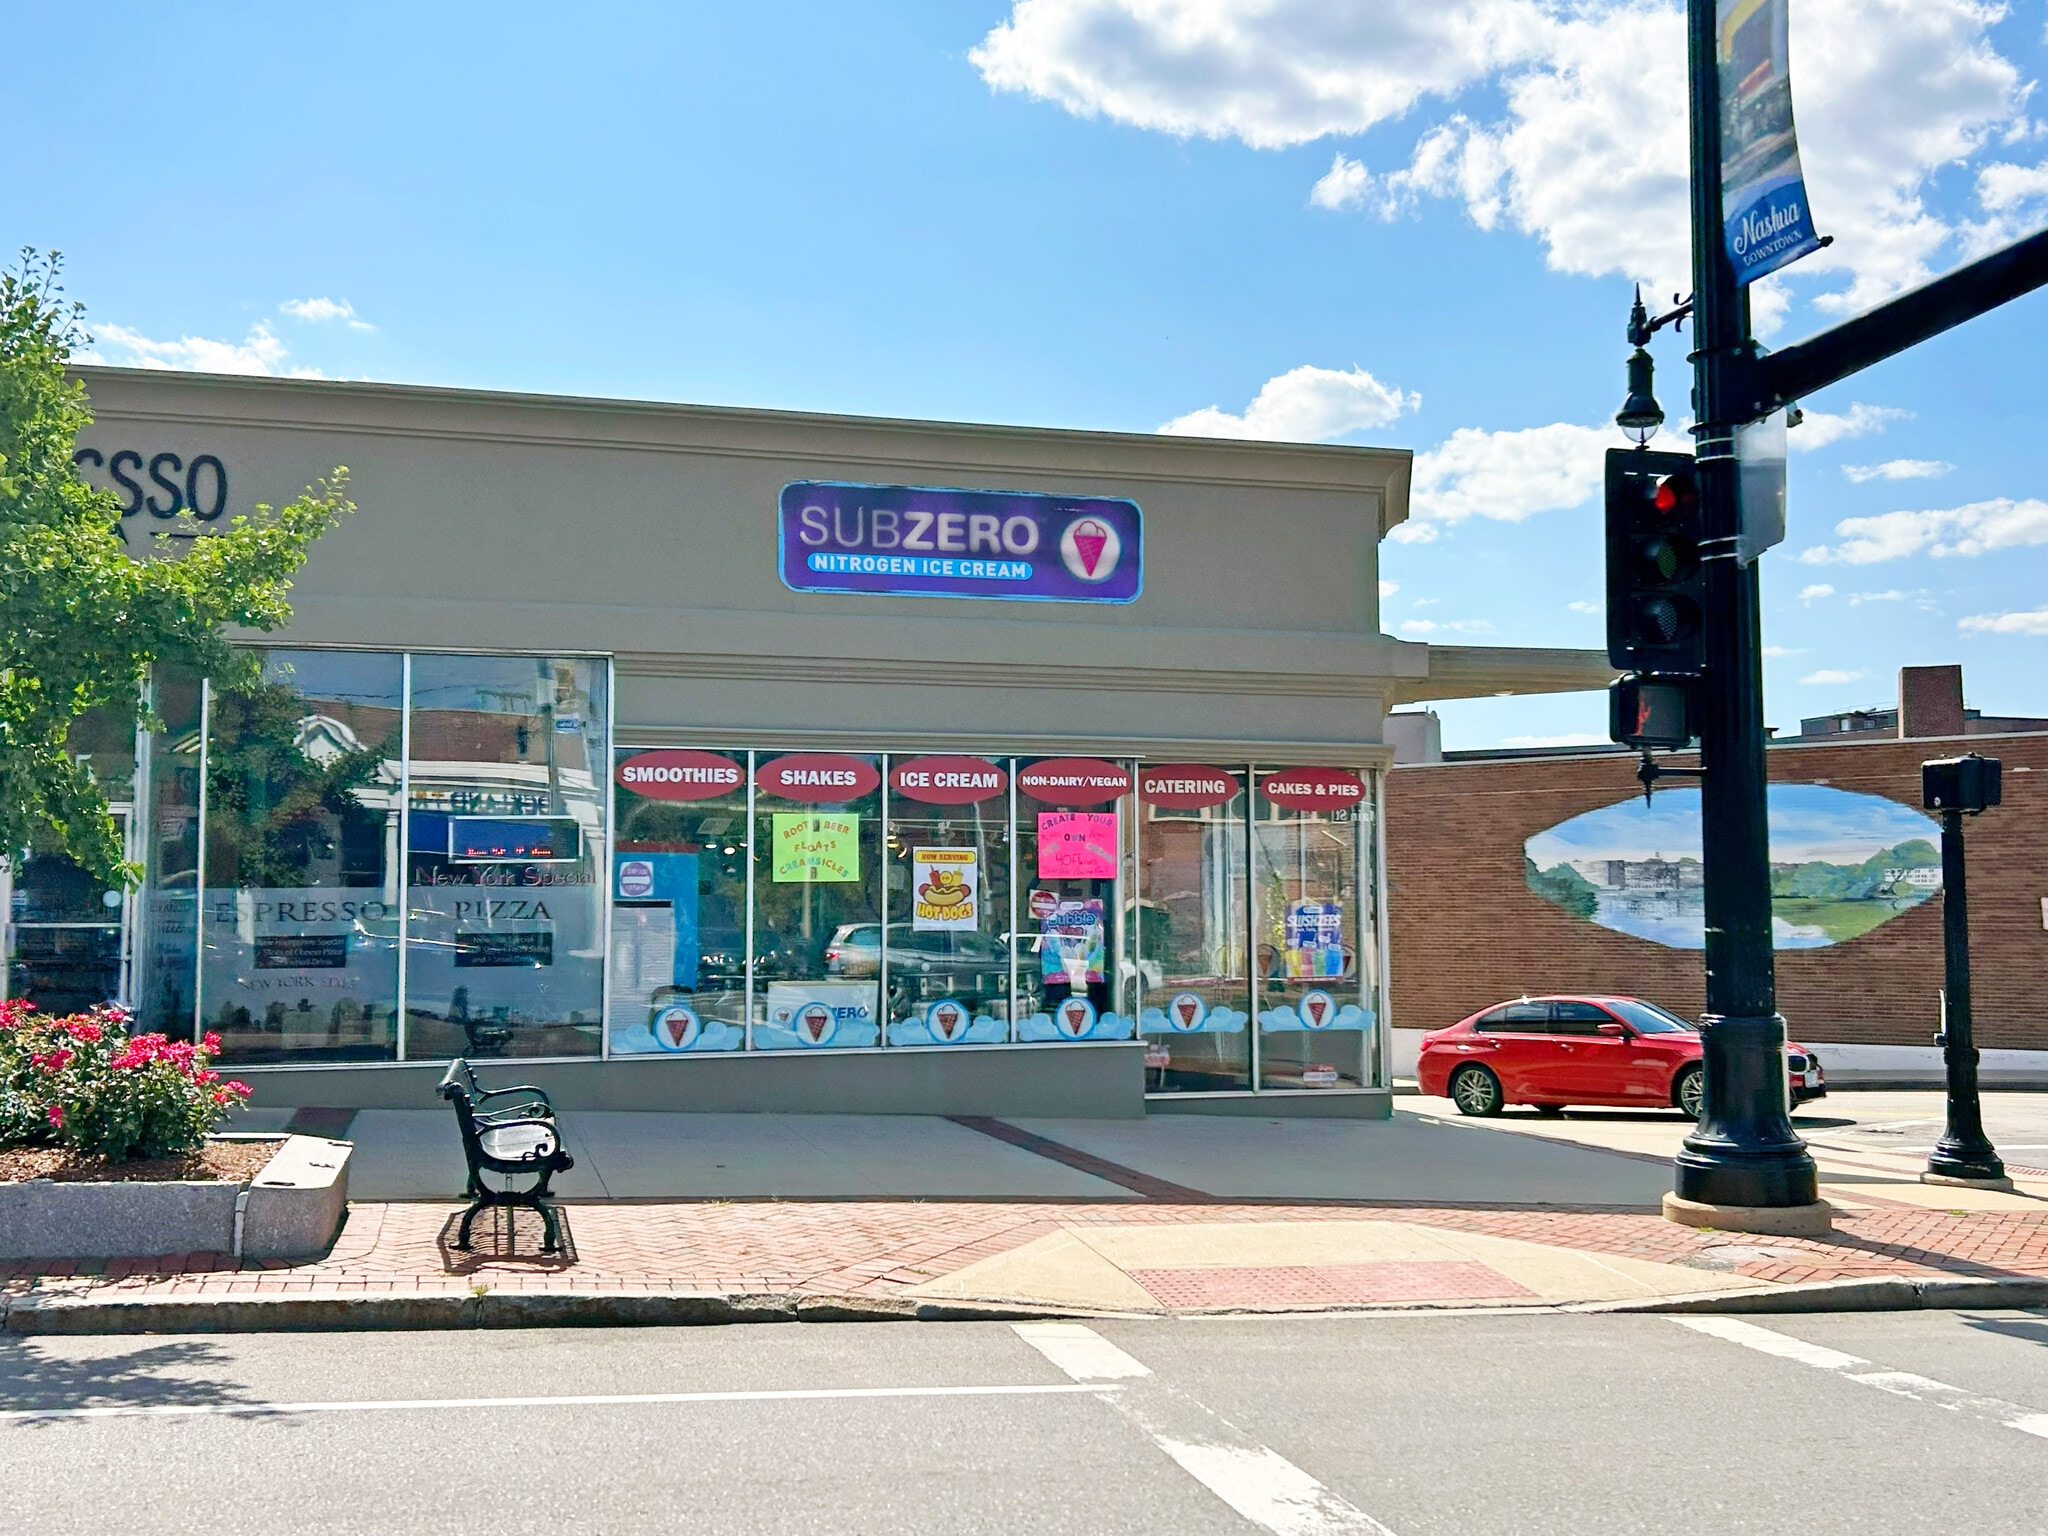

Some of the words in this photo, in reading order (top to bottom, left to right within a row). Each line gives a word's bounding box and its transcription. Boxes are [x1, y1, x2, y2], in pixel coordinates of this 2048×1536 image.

[1734, 203, 1800, 255] Nashua
[1743, 230, 1803, 266] DOWNTOWN
[800, 505, 1039, 555] SUBZERO
[814, 555, 915, 574] NITROGEN
[923, 559, 953, 575] ICE
[960, 560, 1026, 578] CREAM
[622, 766, 738, 784] SMOOTHIES
[780, 769, 857, 787] SHAKES
[900, 771, 930, 788] ICE
[933, 772, 999, 789] CREAM
[1022, 775, 1127, 788] NON-DAIRY/VEGAN
[1144, 779, 1226, 795] CATERING
[1267, 782, 1312, 796] CAKES
[1314, 783, 1326, 796] &
[1328, 783, 1359, 797] PIES
[783, 820, 808, 840] ROOT
[823, 820, 850, 834] BEER
[1041, 813, 1076, 831] CREATE
[1087, 813, 1113, 828] YOUR
[793, 840, 837, 853] FLOATS
[1064, 833, 1086, 842] OWN
[413, 866, 468, 886] New
[470, 866, 517, 887] York
[522, 866, 597, 887] Special
[779, 857, 849, 878] CREAMSICLES
[215, 901, 388, 923] ESPRESSO
[455, 900, 552, 920] PIZZA
[916, 901, 940, 920] HOT
[941, 901, 974, 921] DOGS
